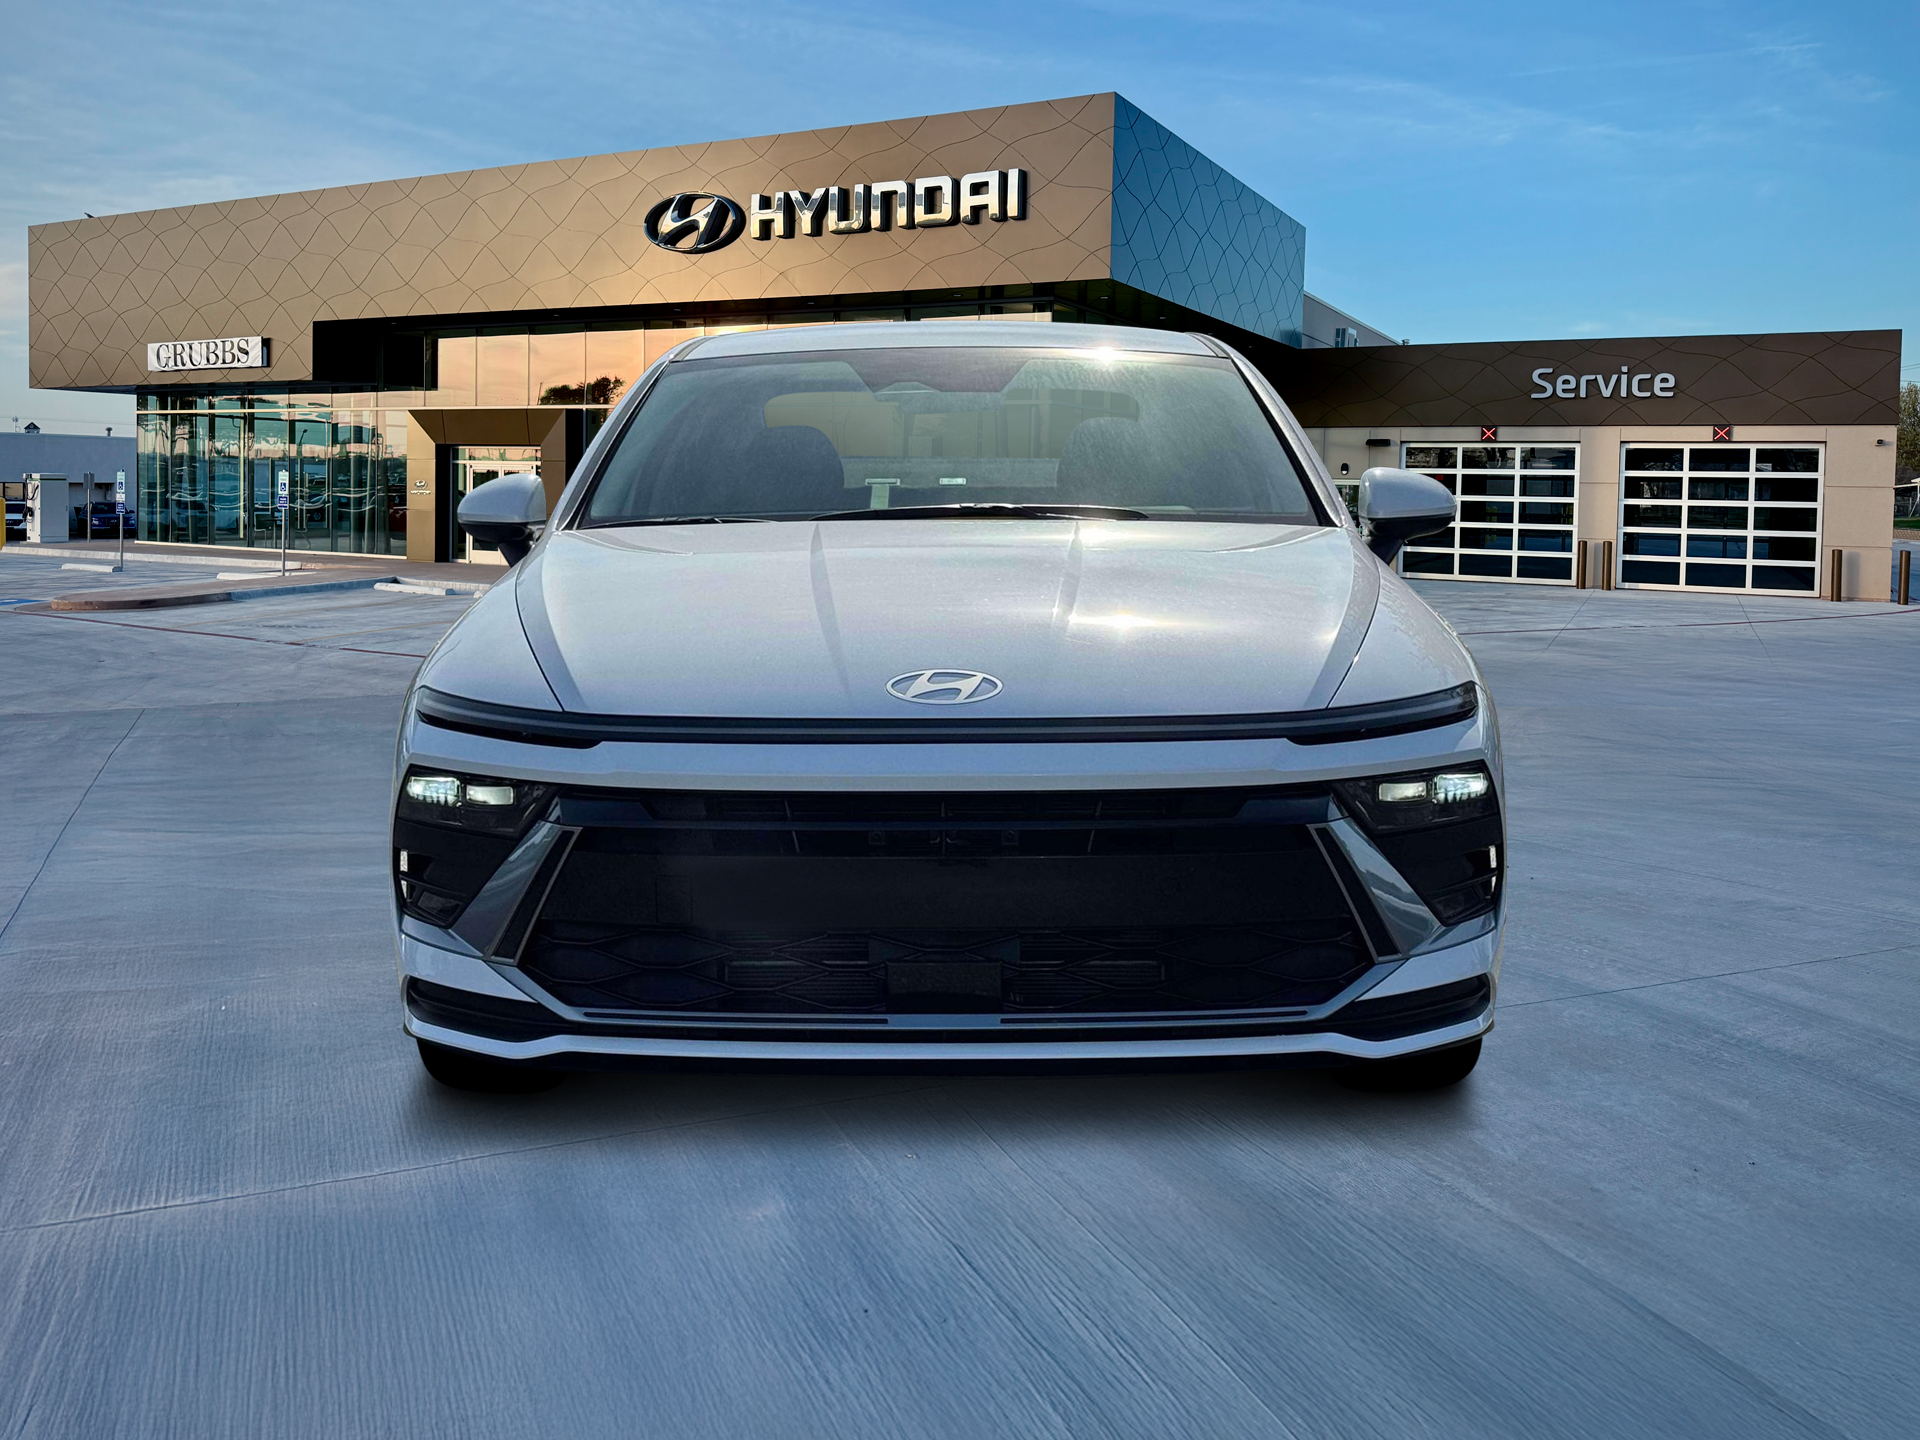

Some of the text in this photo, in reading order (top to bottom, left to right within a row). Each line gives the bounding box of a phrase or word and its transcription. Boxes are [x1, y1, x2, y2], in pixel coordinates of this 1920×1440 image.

[750, 168, 1026, 240] HYUNDAI
[156, 338, 249, 369] GRUBBS
[1530, 365, 1676, 399] Service
